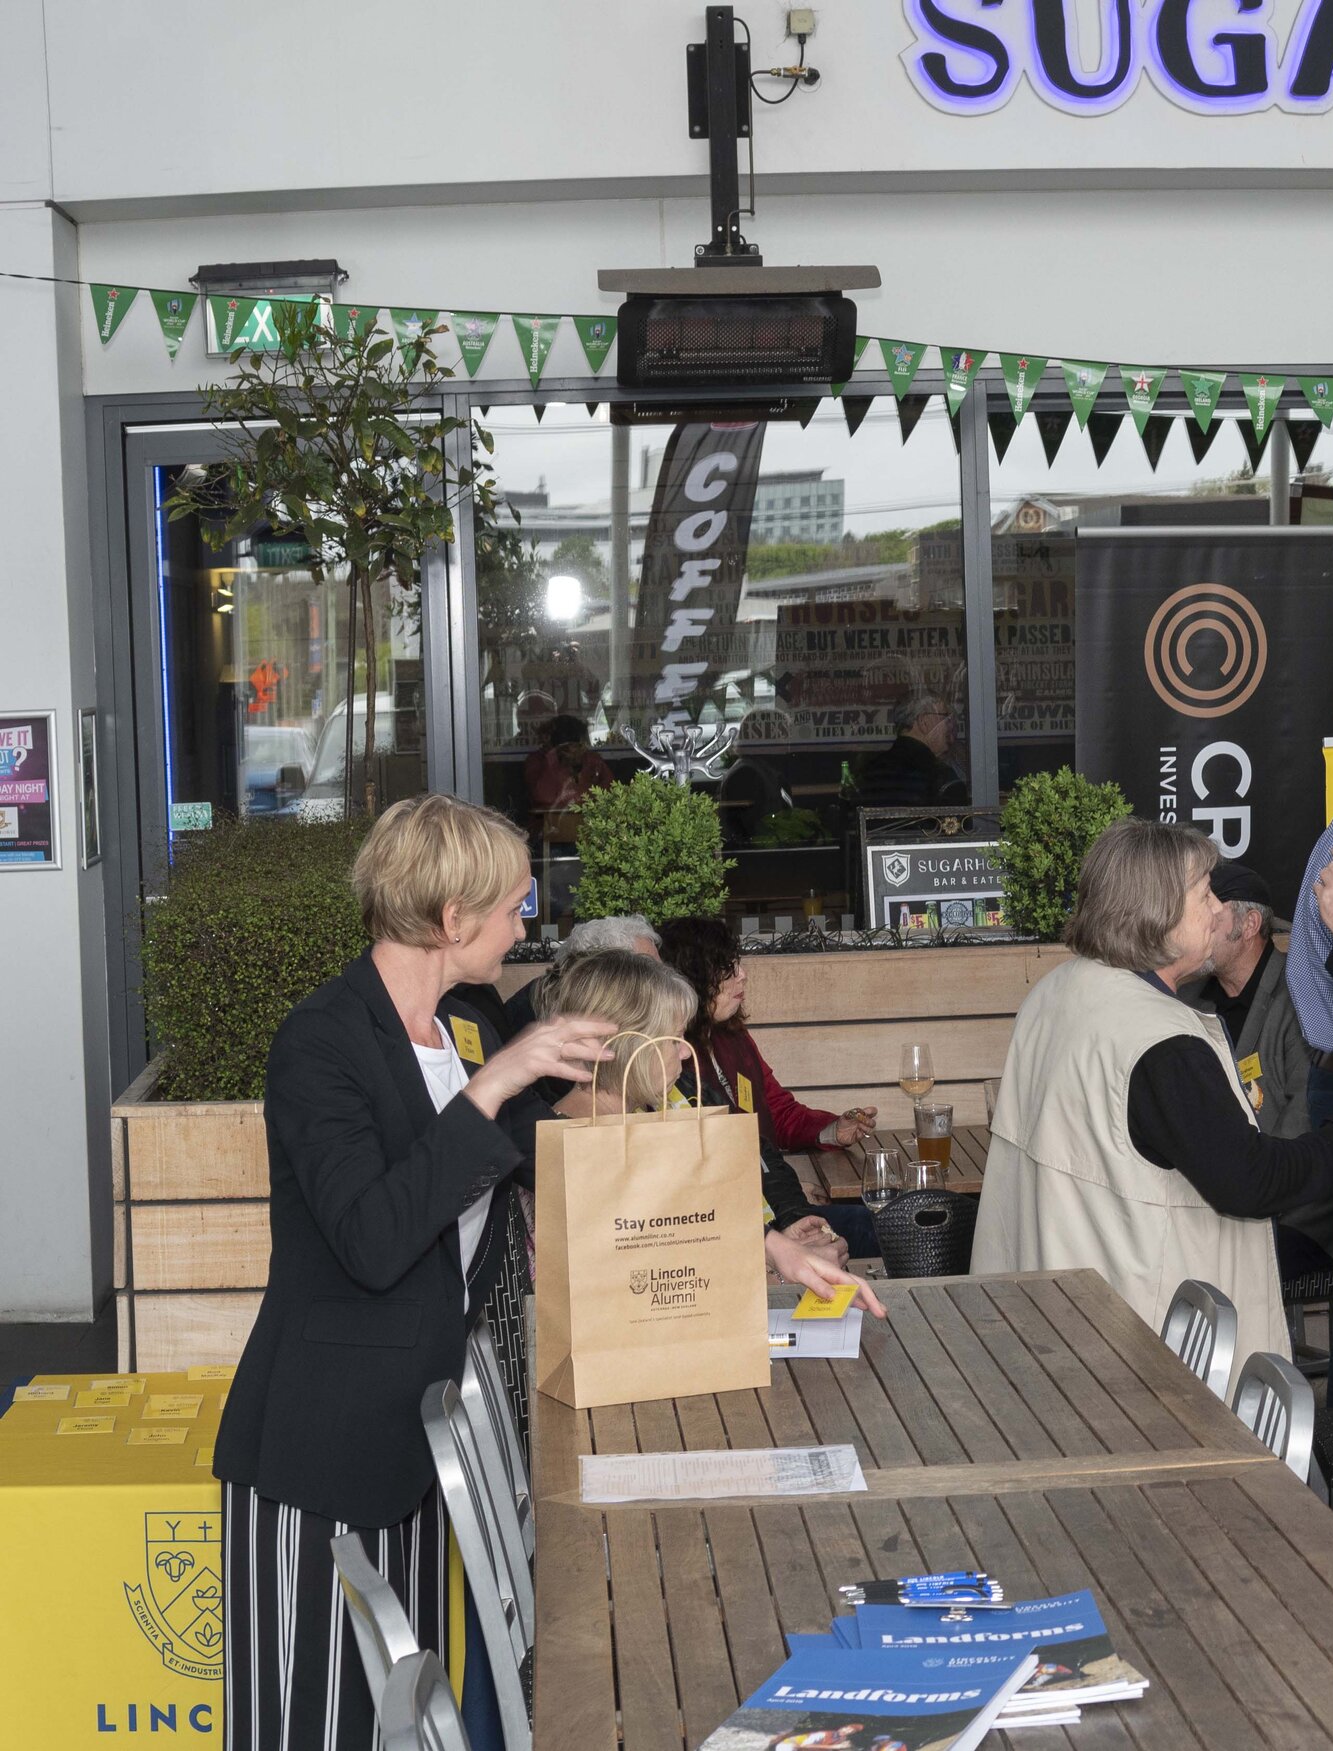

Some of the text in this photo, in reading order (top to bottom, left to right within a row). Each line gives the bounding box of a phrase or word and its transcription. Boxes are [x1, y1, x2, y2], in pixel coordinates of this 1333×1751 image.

[101, 301, 116, 338] Heineken
[222, 311, 236, 346] Heineken
[530, 332, 539, 373] Heineken
[1015, 372, 1025, 412] Heineken
[1256, 390, 1266, 430] Heineken
[806, 630, 838, 651] BUT
[844, 628, 891, 650] WEEK
[896, 626, 951, 650] AFTER
[812, 709, 884, 726] VERY
[17, 729, 30, 747] IT
[814, 726, 846, 738] THEY
[15, 782, 45, 794] NIGHT
[1160, 747, 1177, 825] INVES
[1191, 741, 1251, 859] CR
[934, 875, 1003, 887] BAR & EATE
[614, 1210, 715, 1232] Stay connected
[614, 1232, 675, 1243] www.alumnilinc.co.nz
[615, 1235, 721, 1251] facebook.com/LincolnUniversityAlumni
[650, 1266, 696, 1281] Lincoln
[650, 1276, 711, 1293] University
[650, 1289, 696, 1306] Alumni
[133, 1599, 160, 1641] SCIENTIA
[881, 1622, 1085, 1644] Landforms
[773, 1685, 983, 1704] Landforms
[97, 1703, 213, 1733] LINC
